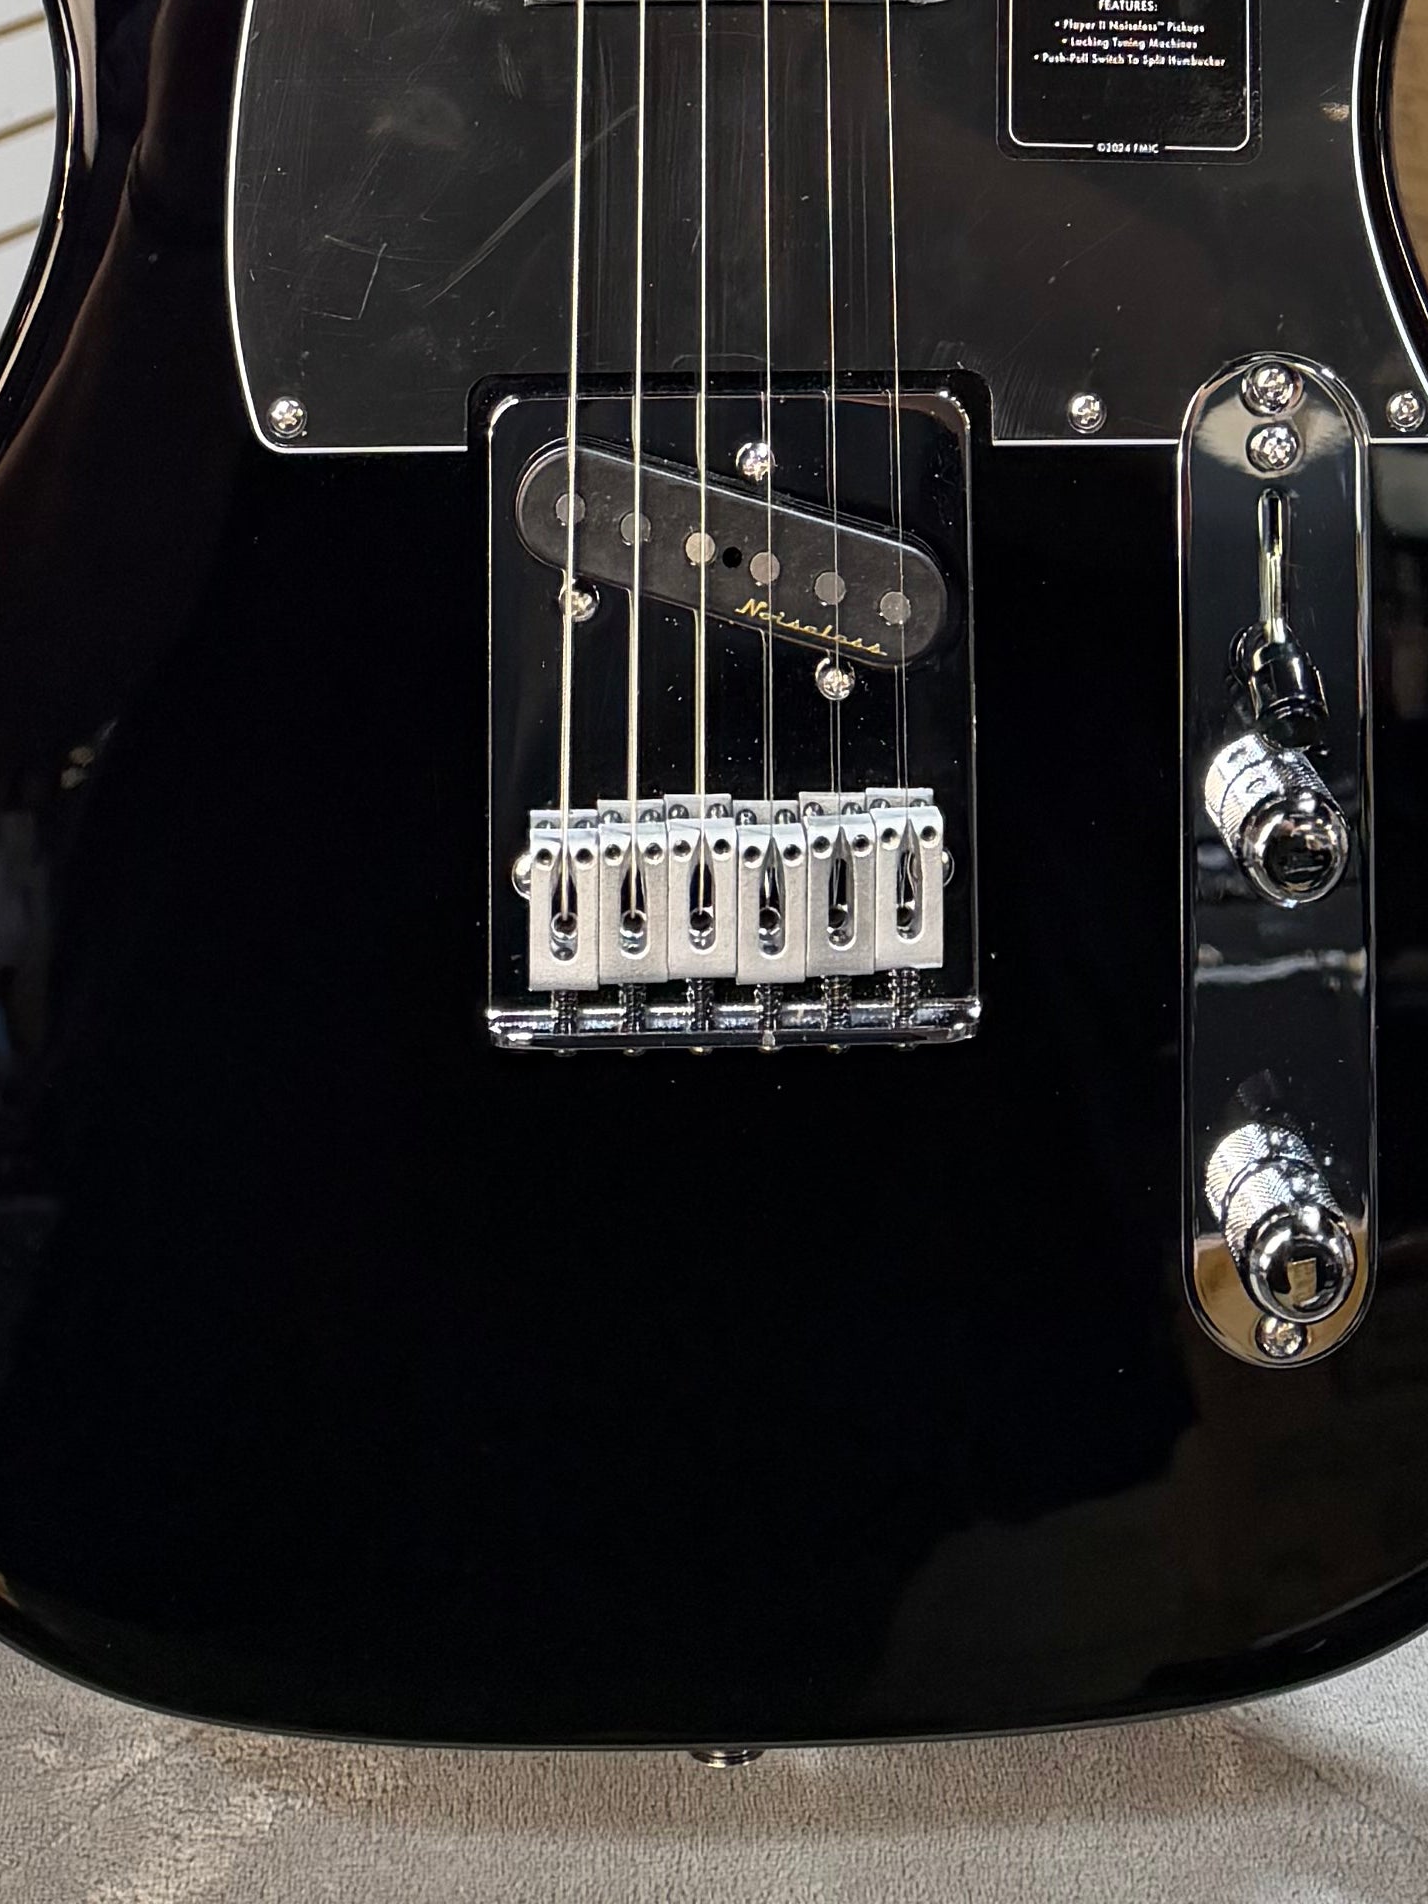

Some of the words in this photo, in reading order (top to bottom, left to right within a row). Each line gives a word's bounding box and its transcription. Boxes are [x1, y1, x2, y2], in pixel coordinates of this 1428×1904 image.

[1098, 0, 1159, 13] FEATURES:
[1167, 21, 1206, 35] Pickups
[1070, 36, 1110, 50] Locking
[1112, 37, 1146, 51] Tuning
[1148, 38, 1198, 49] Machines
[1126, 53, 1140, 65] To
[1168, 55, 1226, 67] Humbucker
[734, 597, 889, 657] Noiseless
